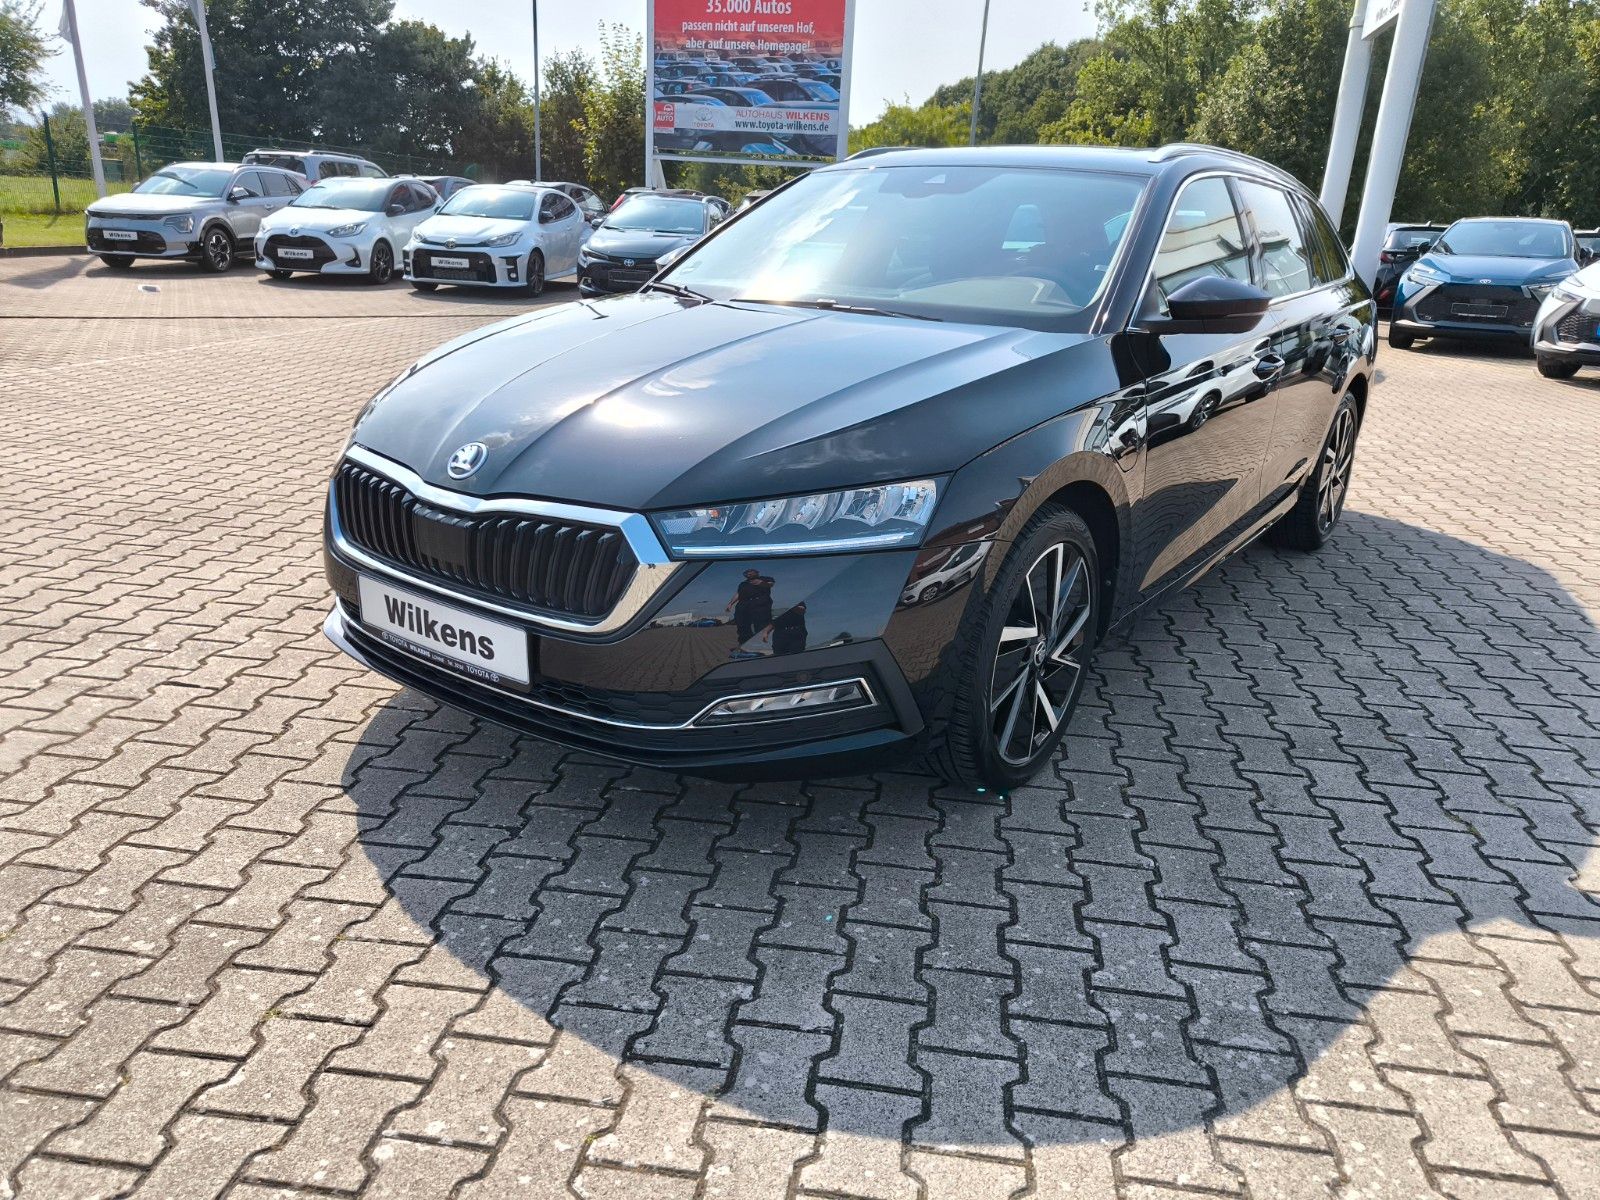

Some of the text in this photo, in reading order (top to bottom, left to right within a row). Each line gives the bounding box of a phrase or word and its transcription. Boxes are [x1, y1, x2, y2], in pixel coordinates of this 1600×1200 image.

[706, 0, 792, 15] 35.000 Autos
[682, 21, 815, 35] passen nicht auf unseren Hof,
[685, 38, 811, 53] aber auf unsere Homepage!
[735, 109, 830, 121] AUTOHAUS WILKENS
[734, 119, 829, 132] www.toyota-wilkens.de
[108, 232, 132, 240] Wilkens
[284, 250, 309, 258] Wilkens
[437, 258, 463, 267] Wilkens
[384, 595, 496, 660] Wilkens
[466, 665, 490, 680] TOYOTA
